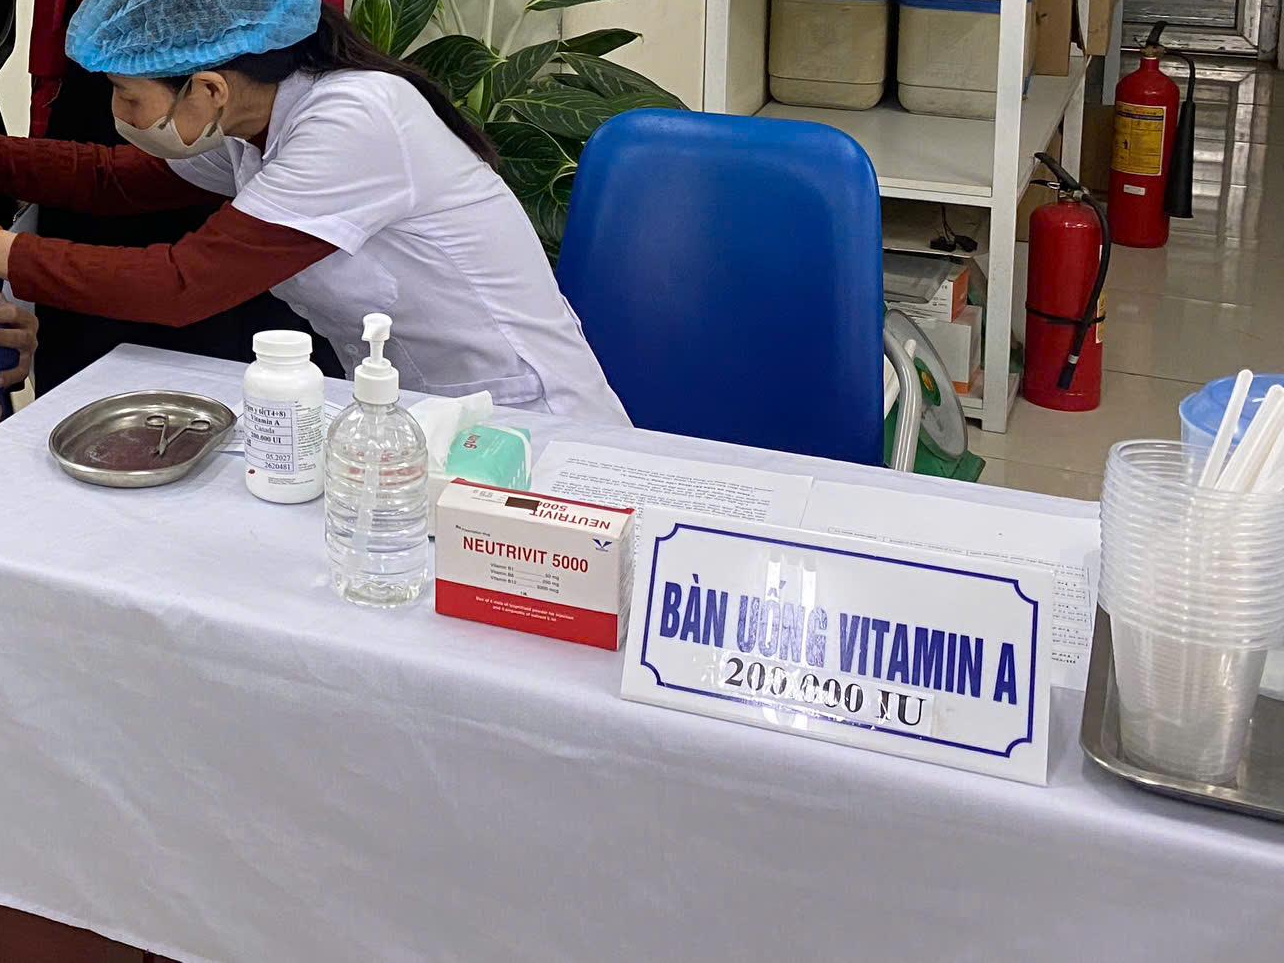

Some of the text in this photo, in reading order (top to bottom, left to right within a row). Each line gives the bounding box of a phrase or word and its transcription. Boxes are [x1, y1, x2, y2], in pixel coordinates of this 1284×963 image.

[250, 414, 272, 425] Vitamin
[254, 425, 275, 434] Canada
[529, 510, 611, 530] NEUTRIVIT
[463, 536, 589, 573] NEUTRIVIT 5000
[660, 573, 729, 648] BÀN
[736, 580, 828, 669] UỐNG
[840, 613, 984, 698] VITAMIN
[993, 643, 1017, 705] A
[724, 657, 927, 726] 200000 IU
